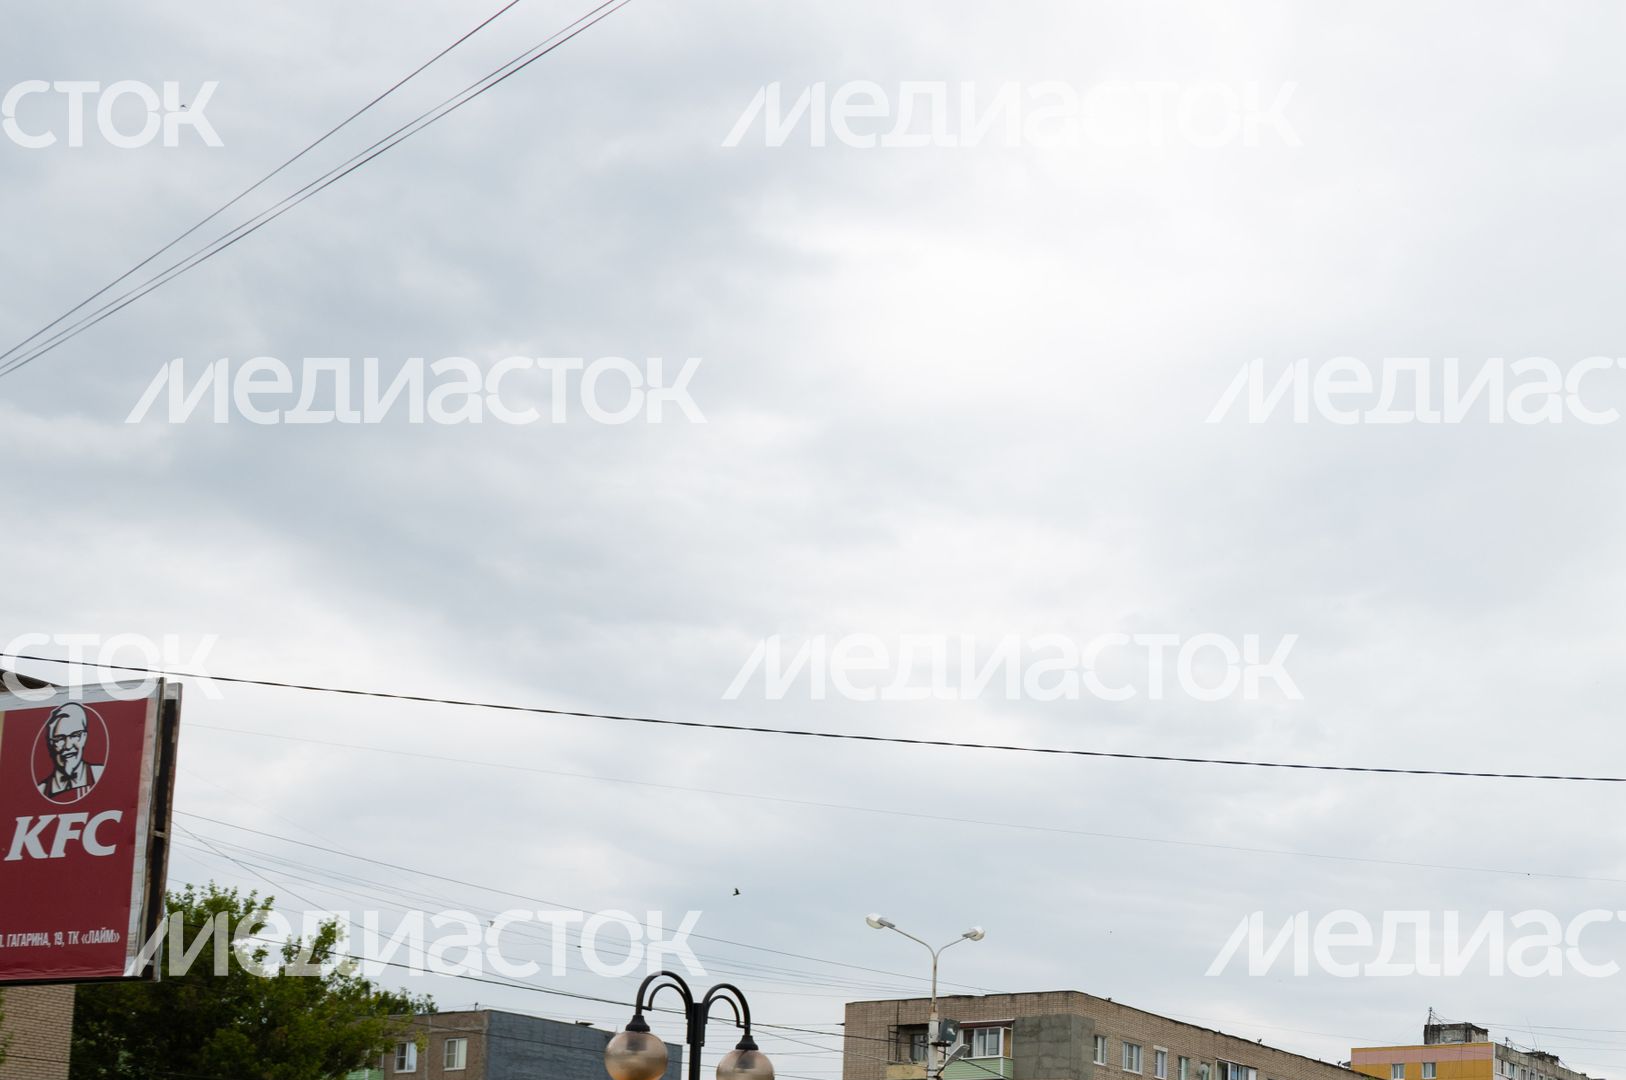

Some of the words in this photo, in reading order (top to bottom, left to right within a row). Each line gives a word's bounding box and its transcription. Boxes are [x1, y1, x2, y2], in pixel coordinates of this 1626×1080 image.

[4, 810, 123, 861] KFC
[6, 932, 51, 948] ГАГАРИНА,
[68, 930, 80, 944] ТК
[81, 927, 120, 944] «ЛАЙМ»
